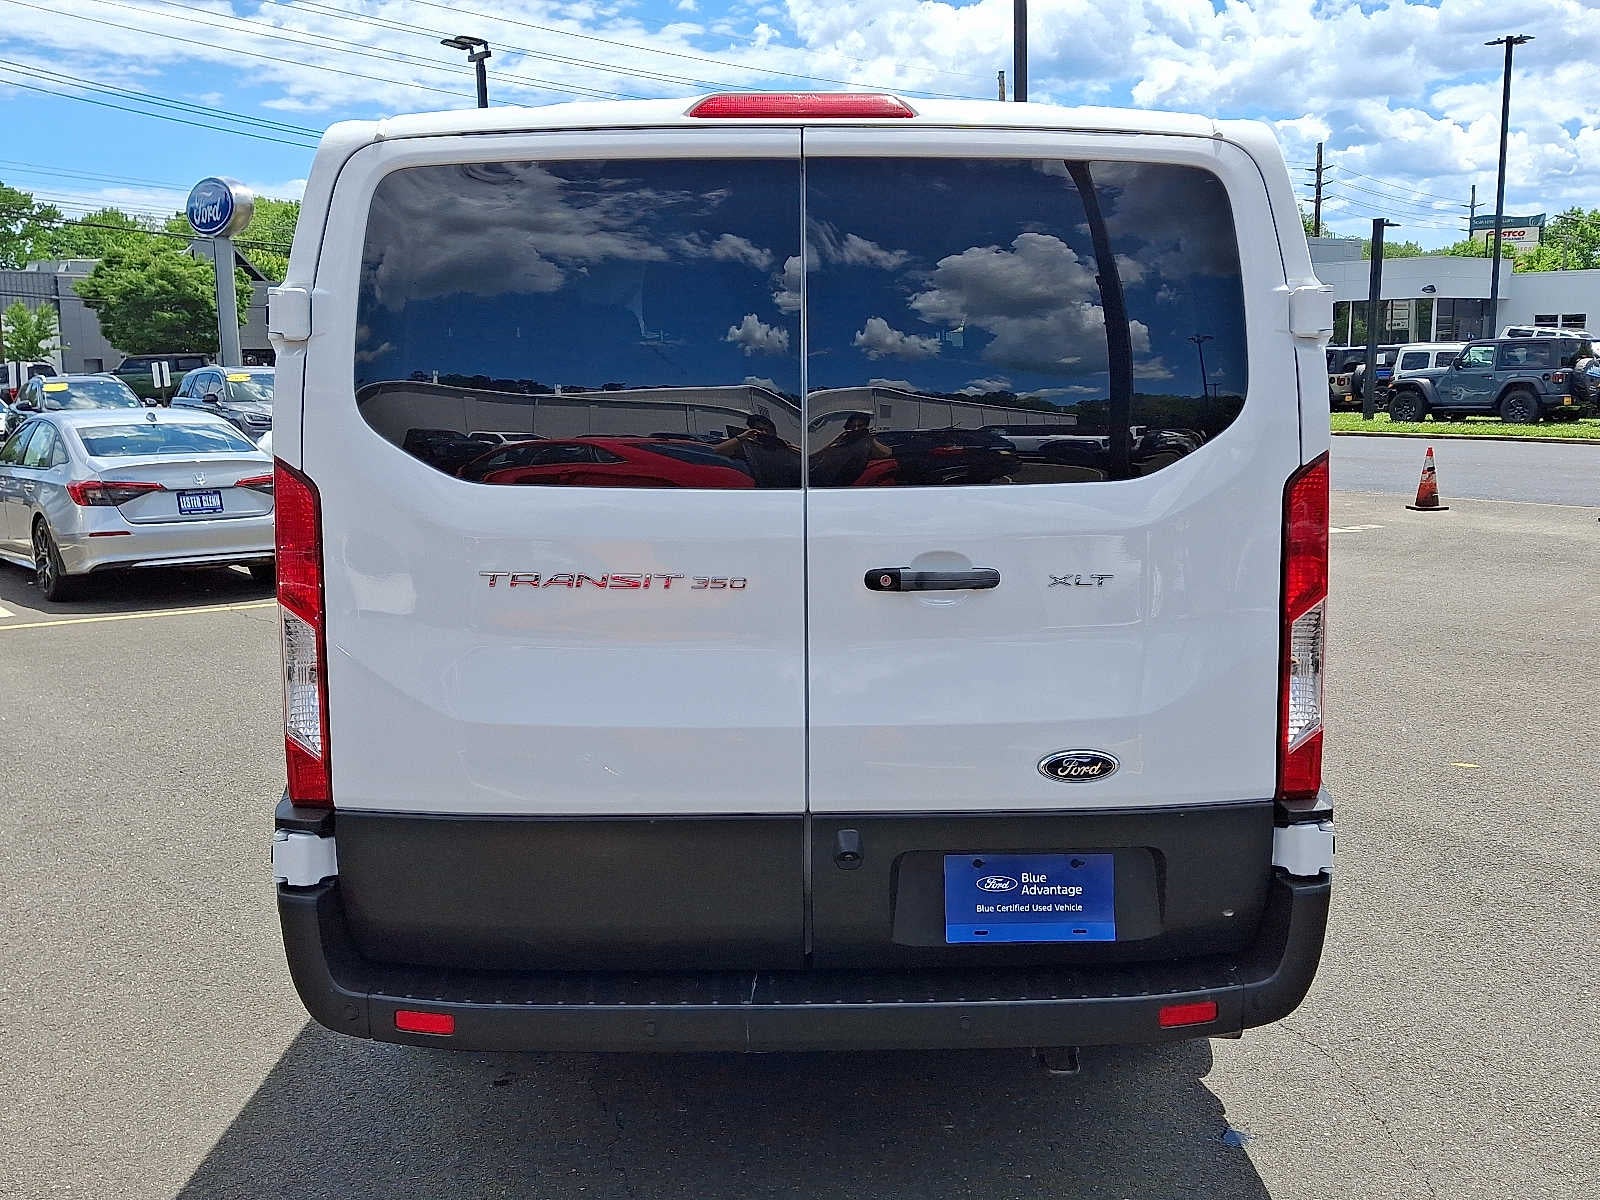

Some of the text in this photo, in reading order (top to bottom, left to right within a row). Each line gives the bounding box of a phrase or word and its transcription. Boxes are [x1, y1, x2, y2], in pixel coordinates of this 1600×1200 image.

[194, 191, 222, 225] Ford
[1488, 230, 1526, 238] CSTCO
[479, 570, 748, 590] TRANSIT 350
[1048, 574, 1114, 588] XLT
[1057, 757, 1102, 776] Ford
[984, 876, 1011, 890] Ford
[1021, 872, 1047, 884] Blue
[1021, 884, 1083, 897] Advantage
[976, 903, 1083, 913] Blue Certified Used Vehicle
